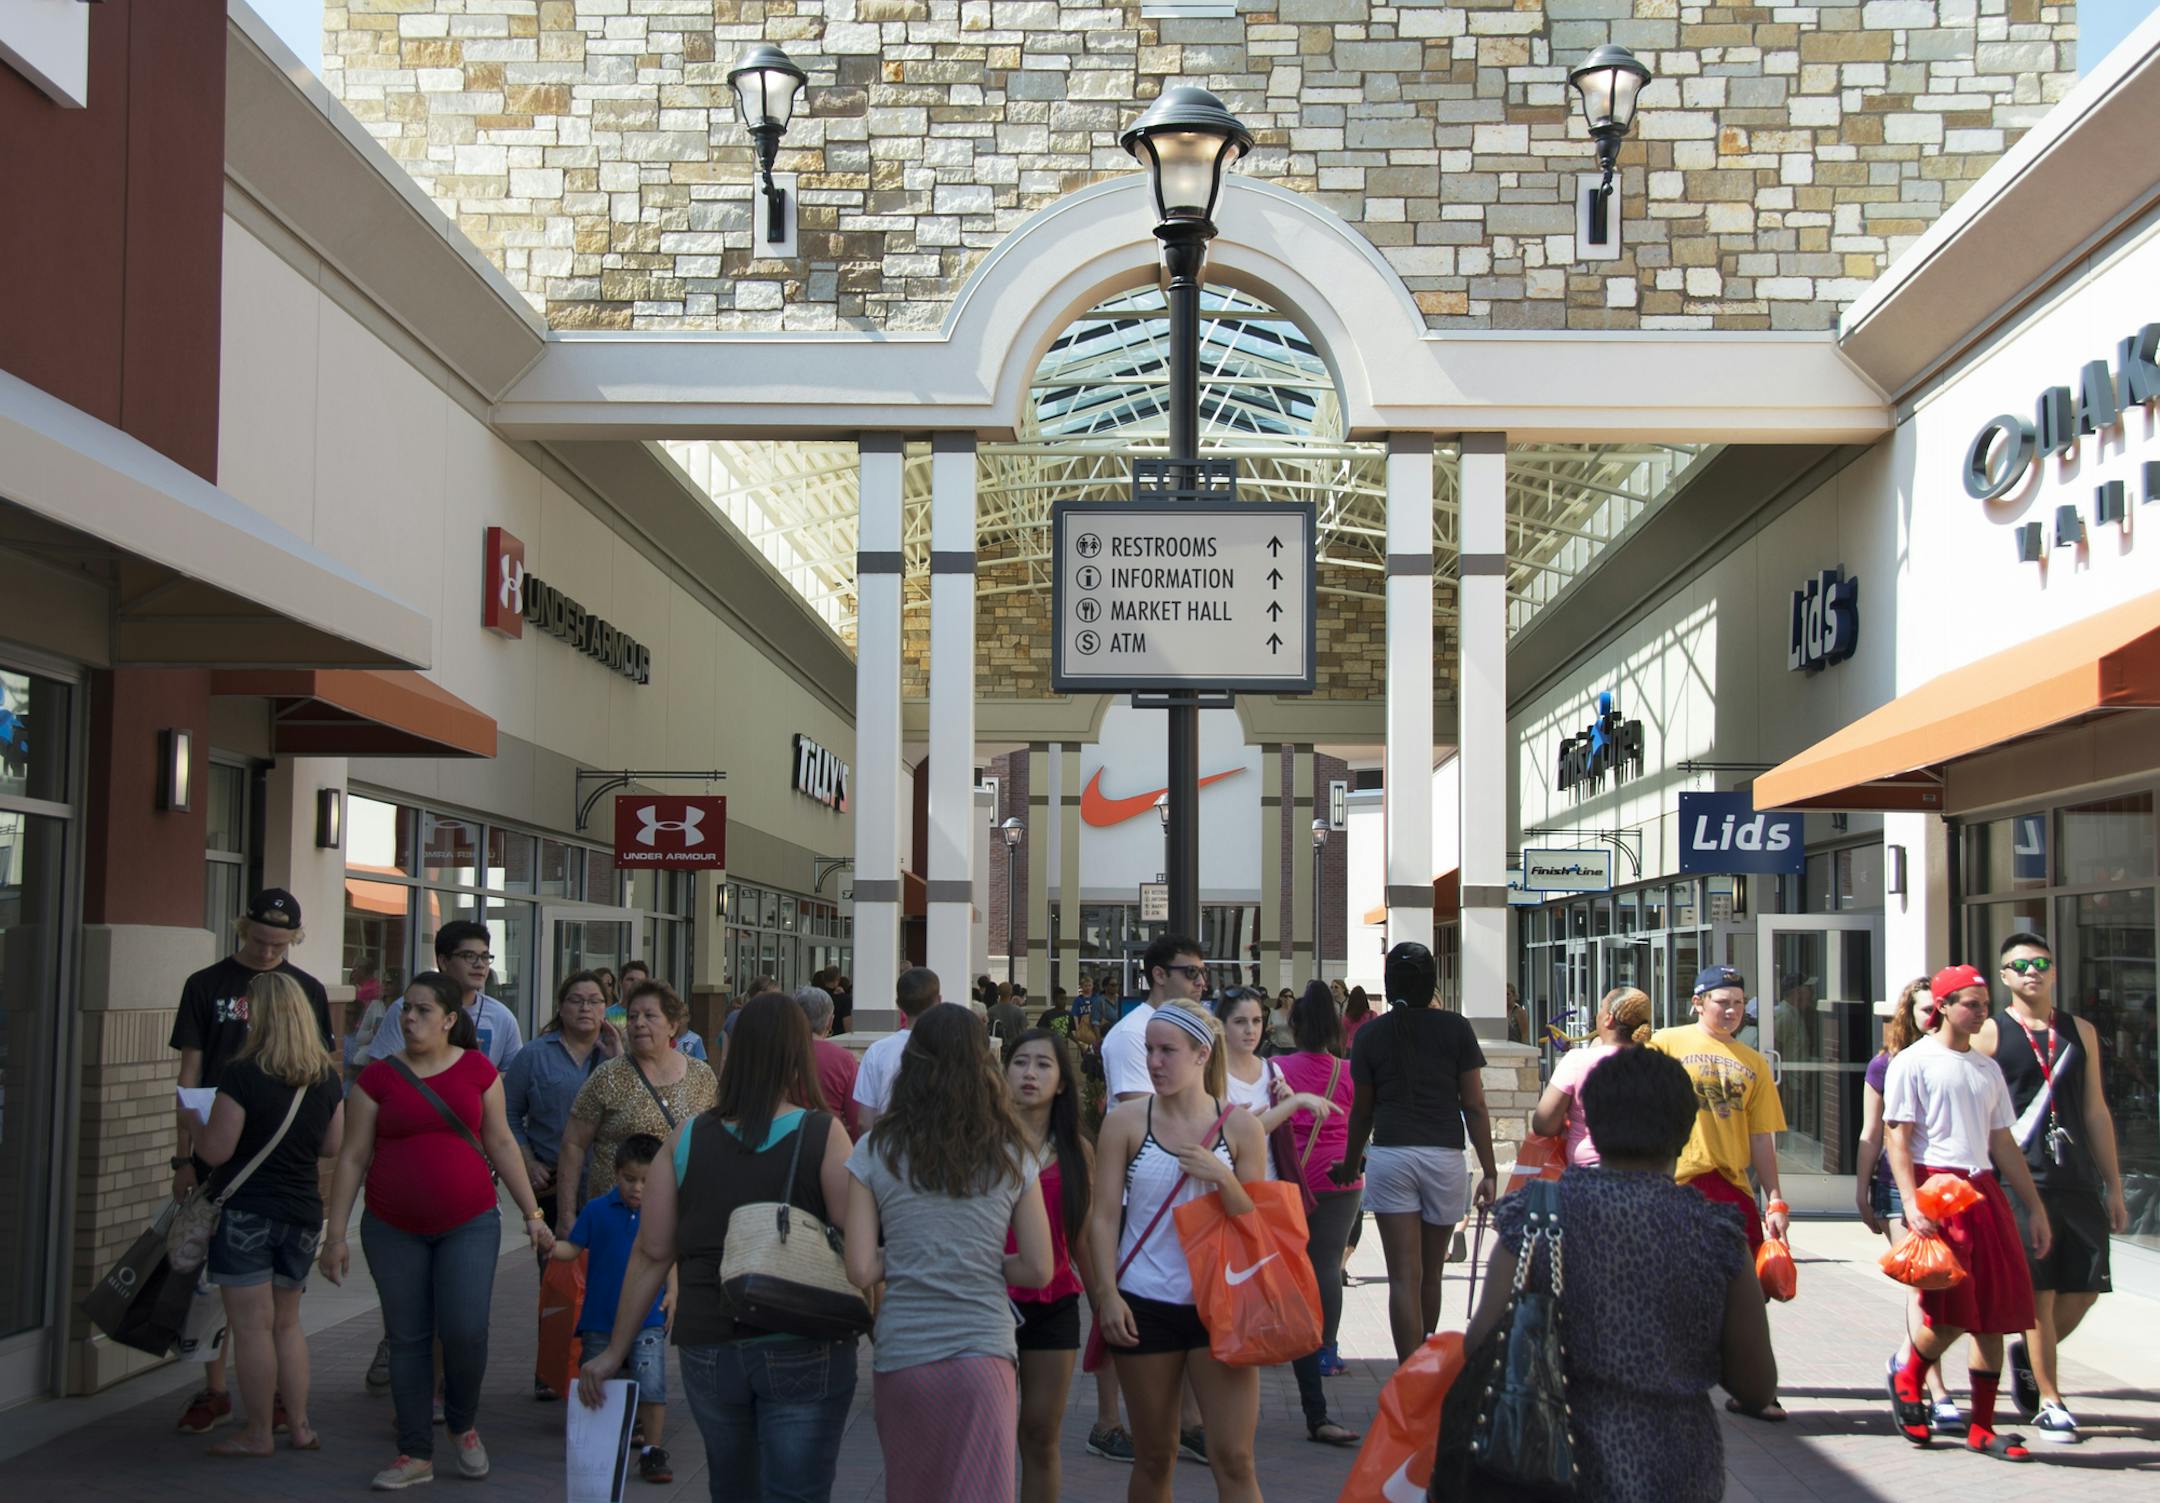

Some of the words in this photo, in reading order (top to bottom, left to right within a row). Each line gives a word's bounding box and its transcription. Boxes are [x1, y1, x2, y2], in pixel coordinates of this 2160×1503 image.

[1111, 536, 1218, 558] RESTROOMS
[1111, 567, 1235, 589] INFORMATION
[1110, 600, 1182, 621] MARKET
[1187, 600, 1233, 621] HALL
[1788, 569, 1846, 672] Lids
[524, 574, 586, 652] UNDER
[587, 615, 650, 685] ARMOUR
[1109, 632, 1147, 653] ATM
[1692, 814, 1791, 851] Lids
[623, 852, 663, 860] UNDER
[1531, 865, 1570, 876] Finish
[1576, 866, 1604, 876] Line
